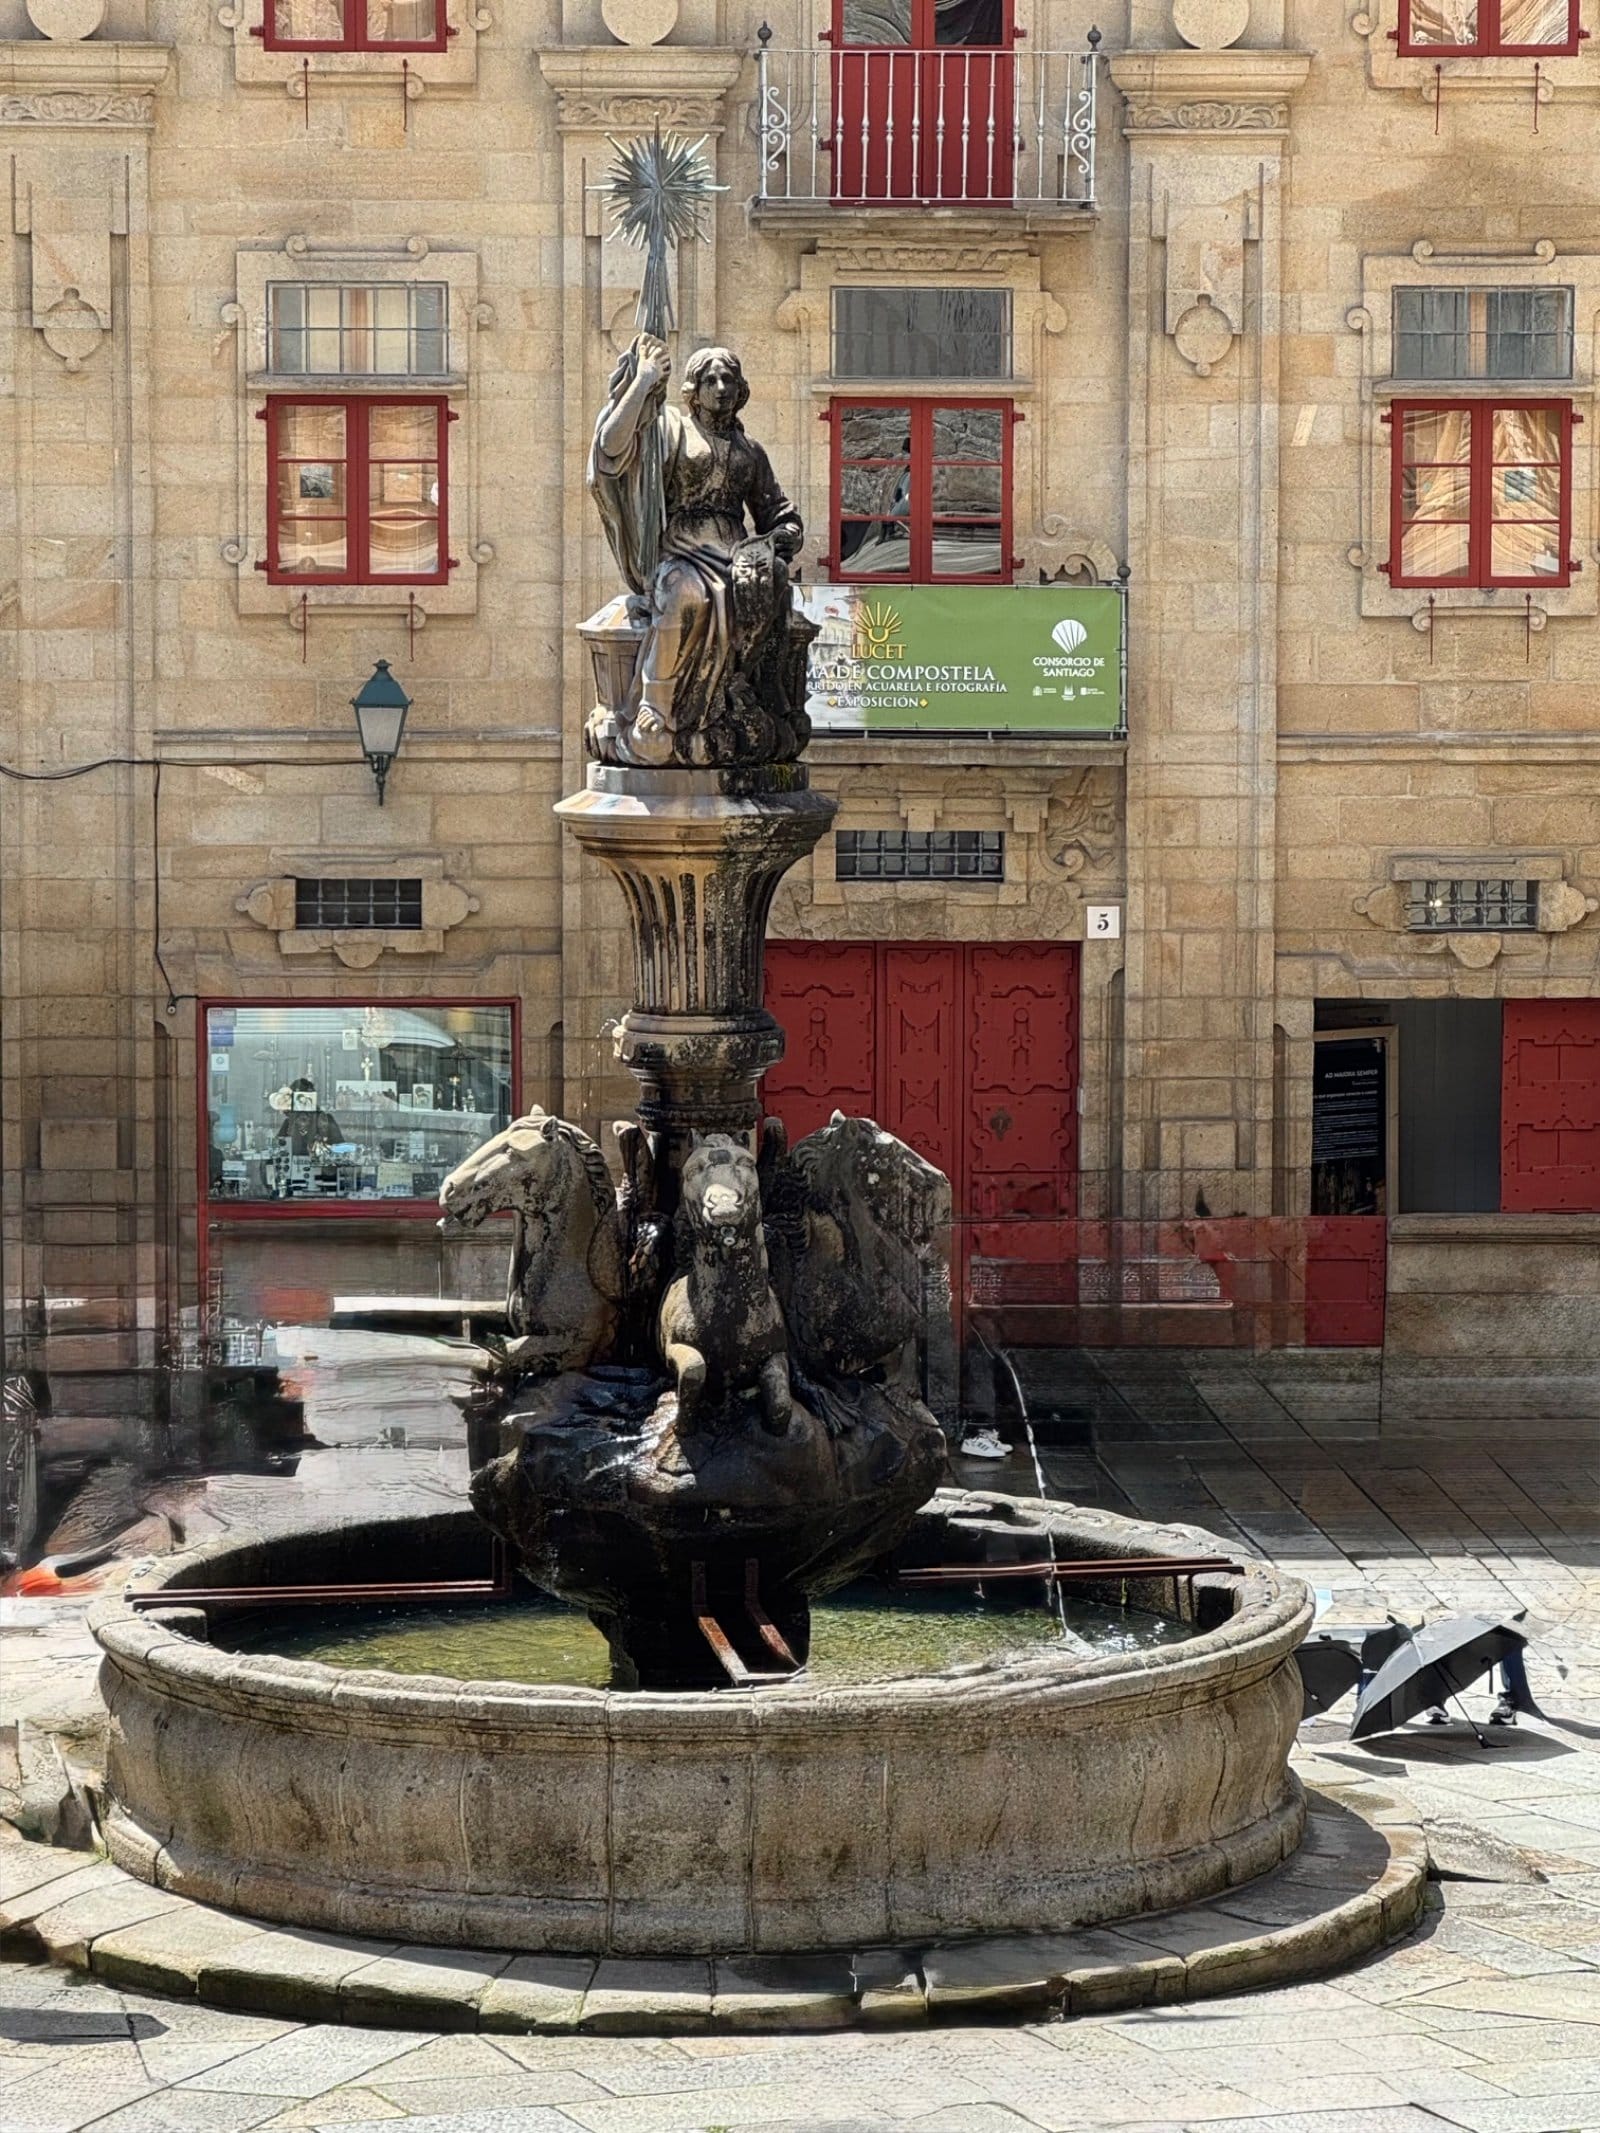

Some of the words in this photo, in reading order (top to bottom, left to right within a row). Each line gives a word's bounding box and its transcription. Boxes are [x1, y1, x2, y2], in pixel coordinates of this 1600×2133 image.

[852, 643, 907, 659] LUCET
[1032, 656, 1092, 667] CONSORCIO
[1093, 657, 1105, 667] DE
[806, 664, 828, 679] MA
[836, 664, 861, 679] DE
[866, 664, 996, 681] COMPOSTELA
[1042, 667, 1095, 677] SANTIAGO
[807, 681, 844, 691] RRIDO
[847, 681, 863, 691] EN
[865, 681, 923, 692] ACUARELA
[926, 682, 932, 692] E
[935, 680, 1008, 693] FOTOGRAFÍA
[837, 694, 919, 708] EXPOSICIÓN
[1096, 912, 1109, 931] 5
